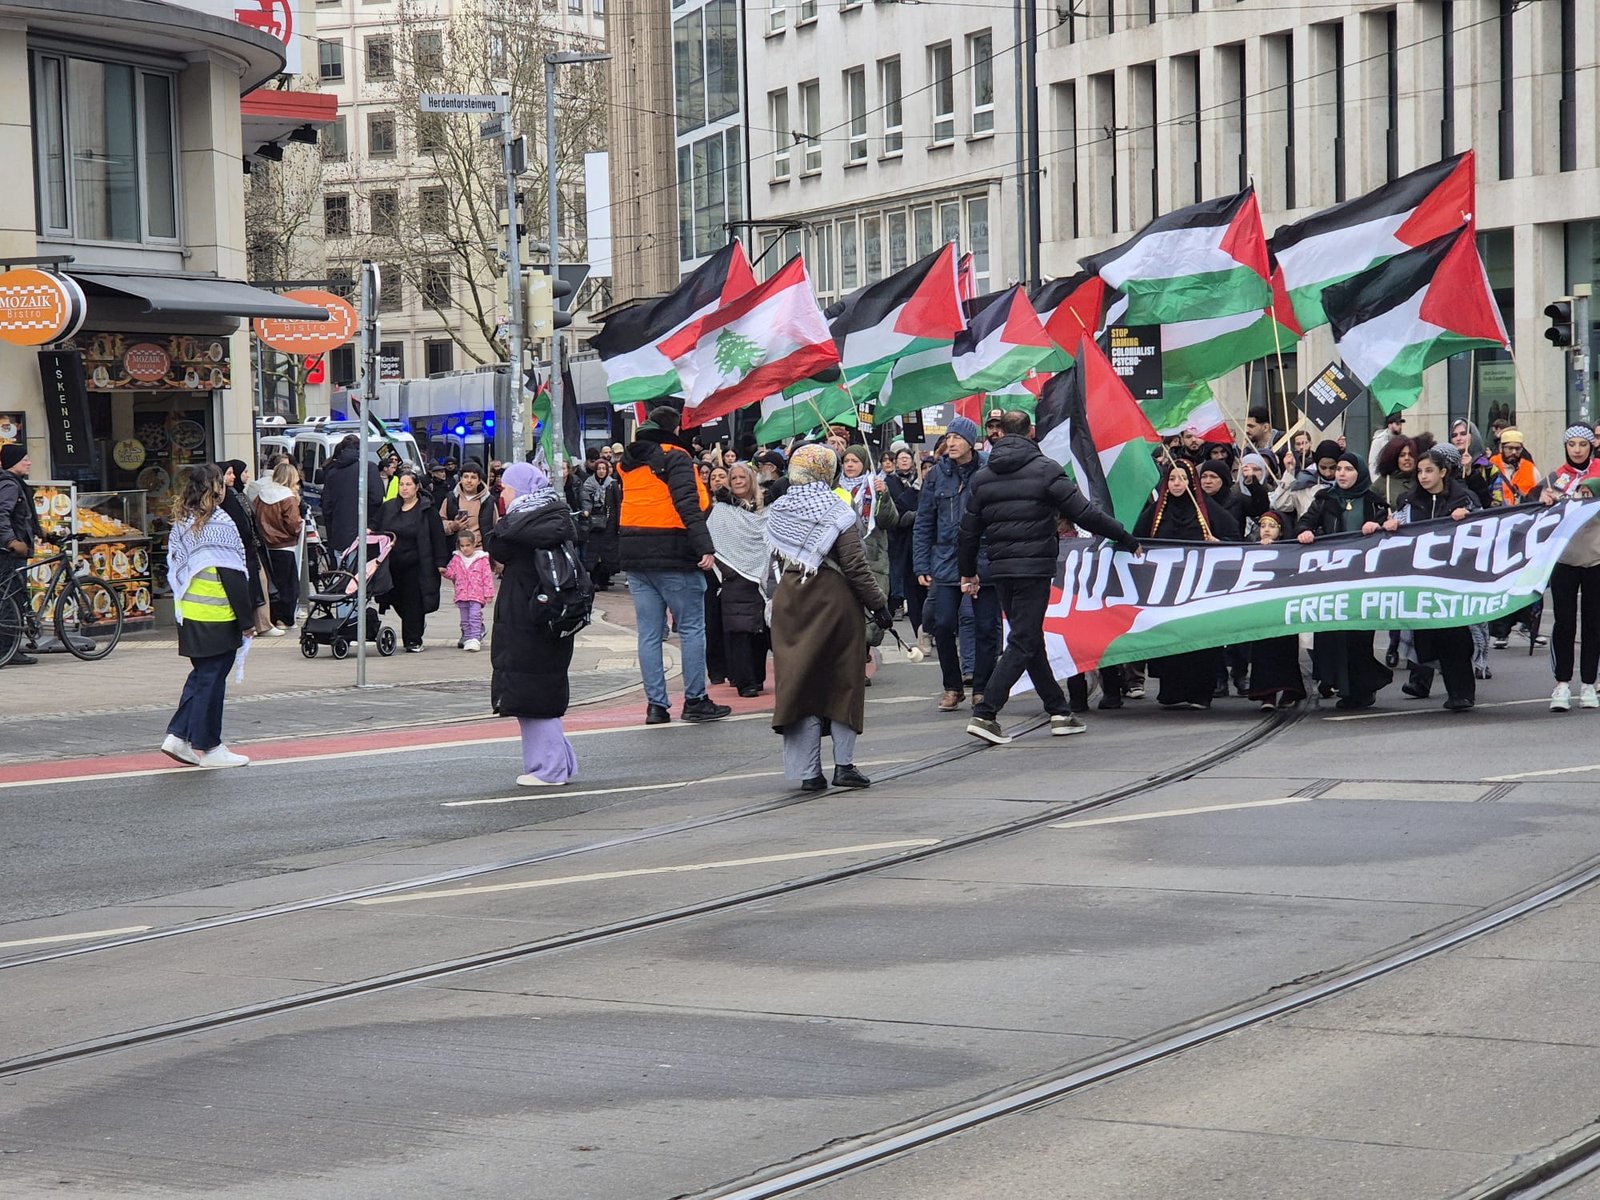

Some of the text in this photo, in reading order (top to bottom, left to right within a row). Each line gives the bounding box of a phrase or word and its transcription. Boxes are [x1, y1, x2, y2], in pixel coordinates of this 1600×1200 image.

[428, 97, 496, 111] Herdentorsteinweg
[0, 295, 51, 308] MOZAIK
[7, 310, 41, 318] Bistro
[1111, 328, 1129, 338] STOP
[1111, 337, 1139, 347] ARMING
[1111, 346, 1155, 357] COLONIALIST
[55, 357, 74, 453] ISKENDER
[1044, 546, 1280, 619] JUSTICE
[1285, 592, 1350, 625] FREE
